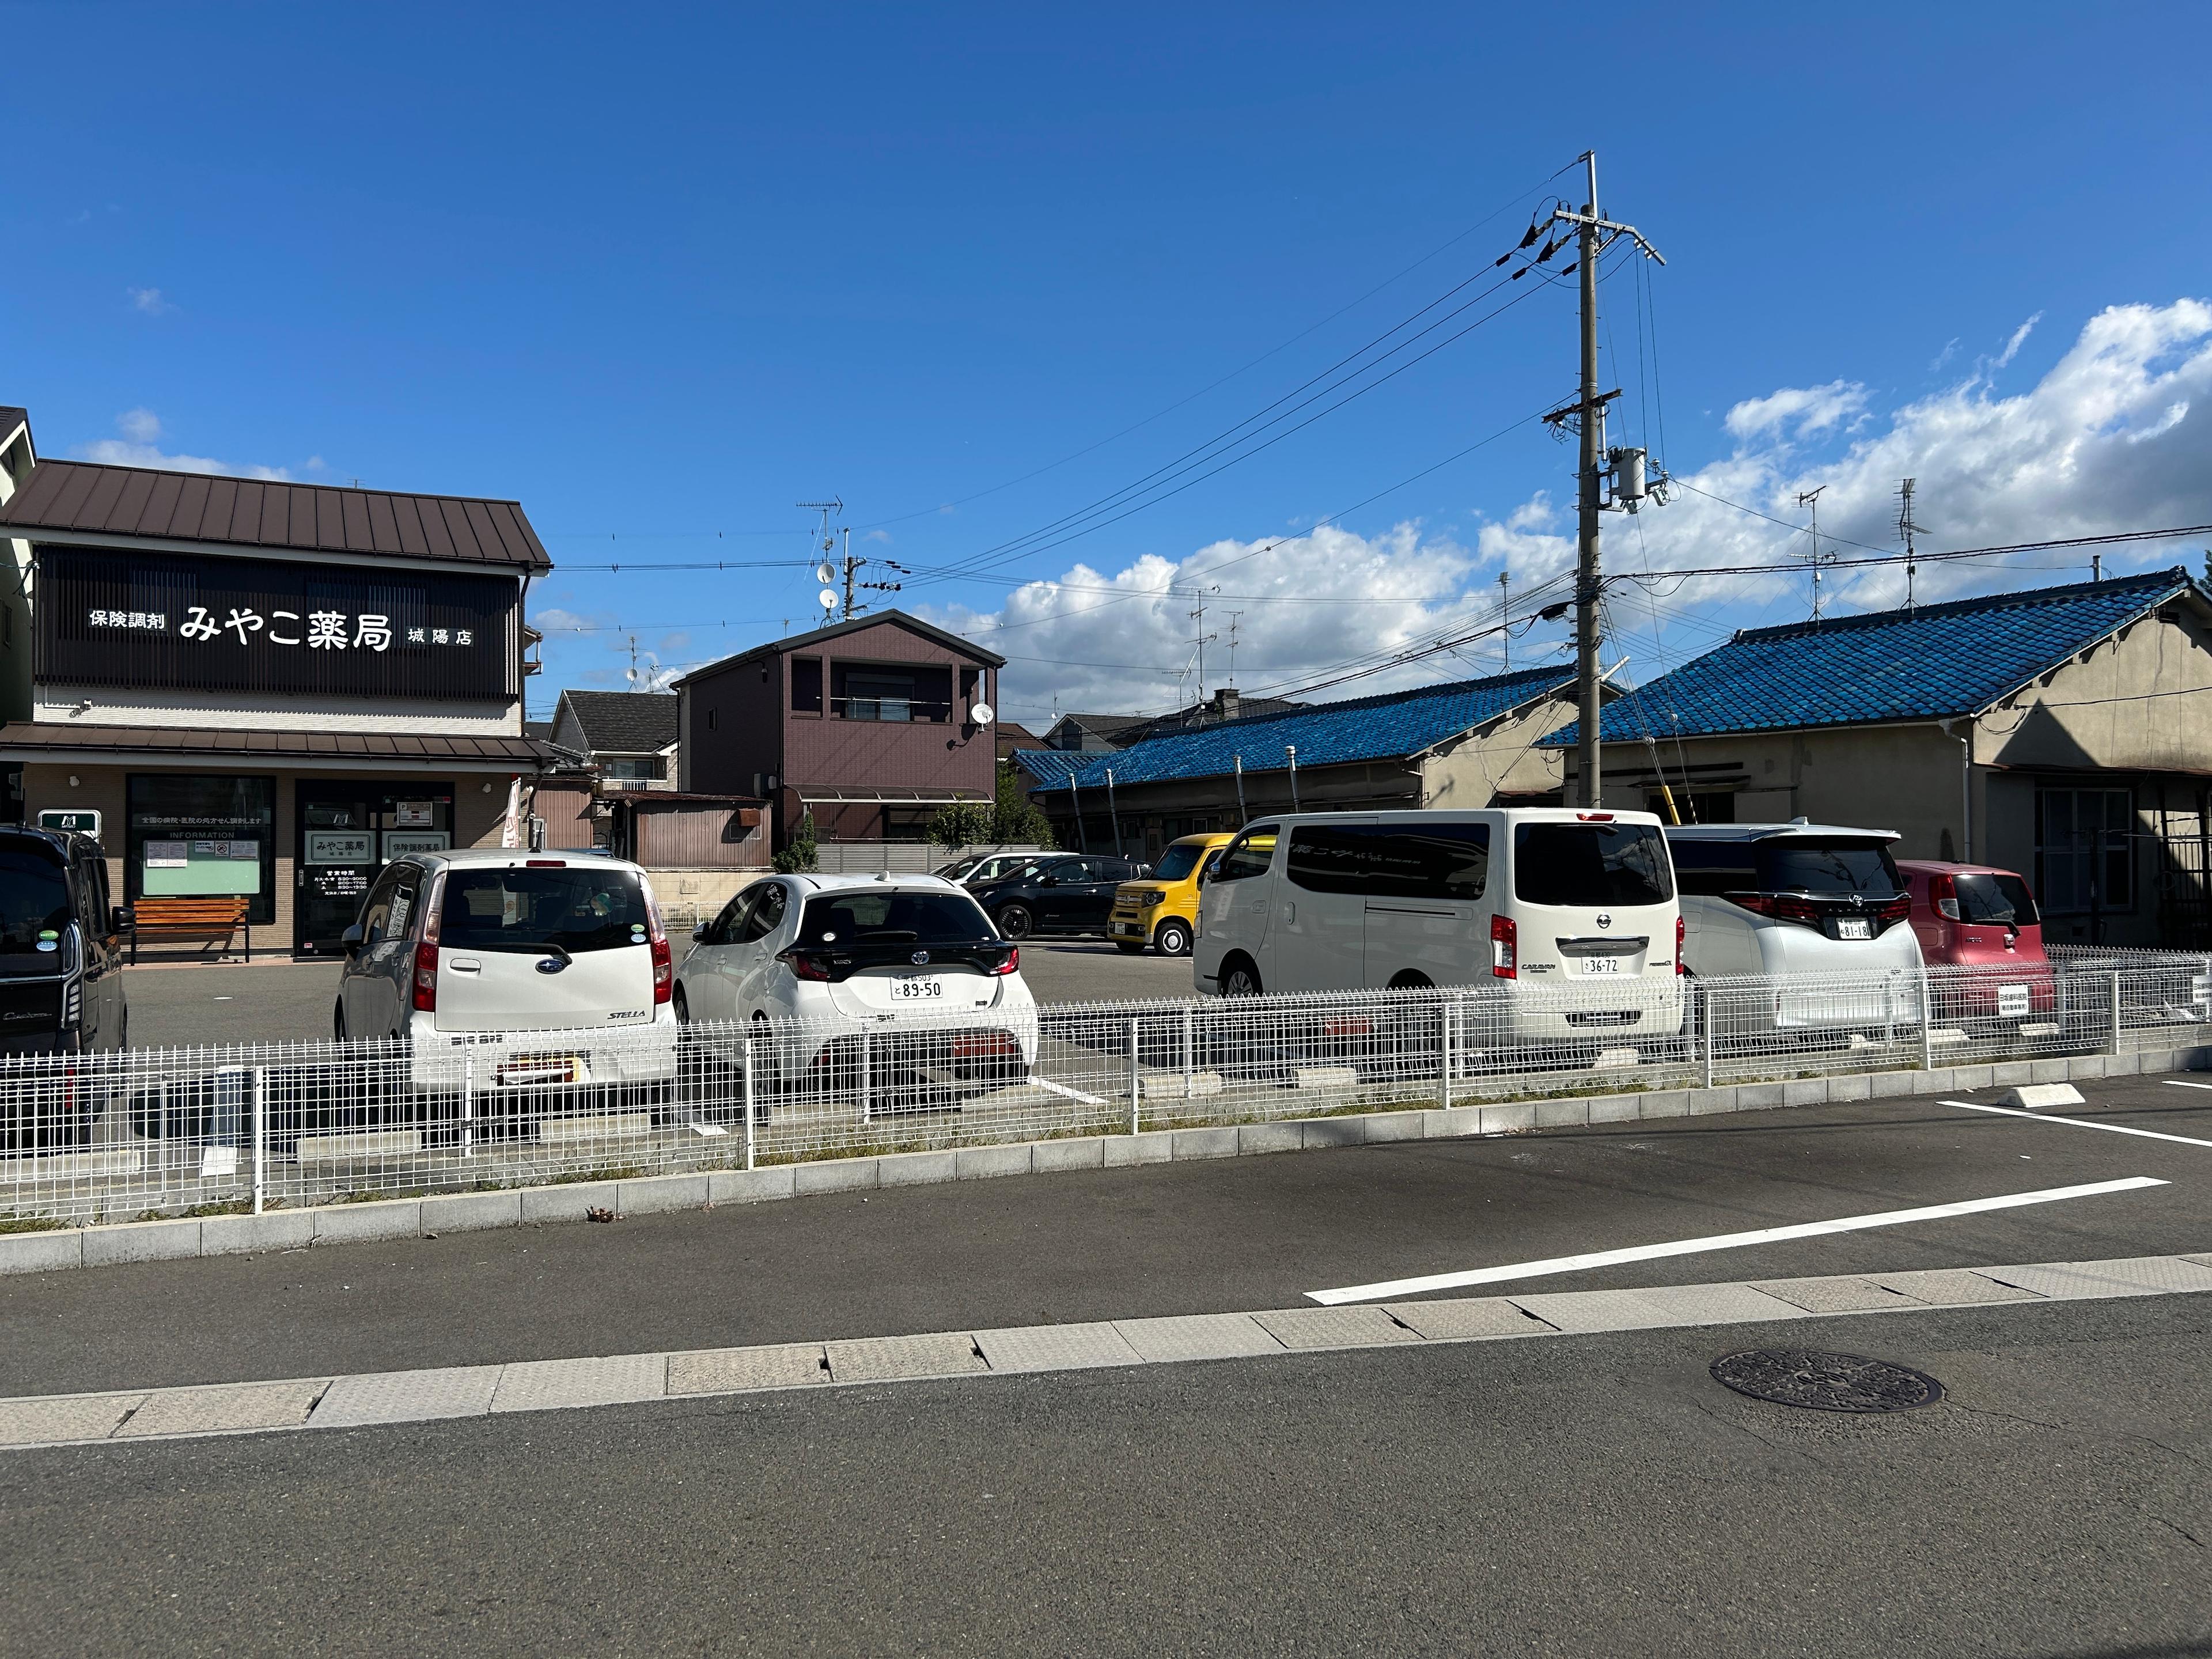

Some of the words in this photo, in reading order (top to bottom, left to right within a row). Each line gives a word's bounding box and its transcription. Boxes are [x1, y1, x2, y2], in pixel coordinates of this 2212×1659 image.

[89, 610, 165, 630] 保険調剤
[180, 607, 392, 652] みやこ薬局
[408, 627, 472, 645] 城陽店
[317, 842, 365, 851] みやこ薬局
[393, 843, 440, 853] 保険調剤薬局
[1844, 926, 1868, 937] 81-18
[1590, 960, 1618, 972] 36-72
[903, 982, 941, 997] 89-50
[607, 1010, 646, 1020] STELLA
